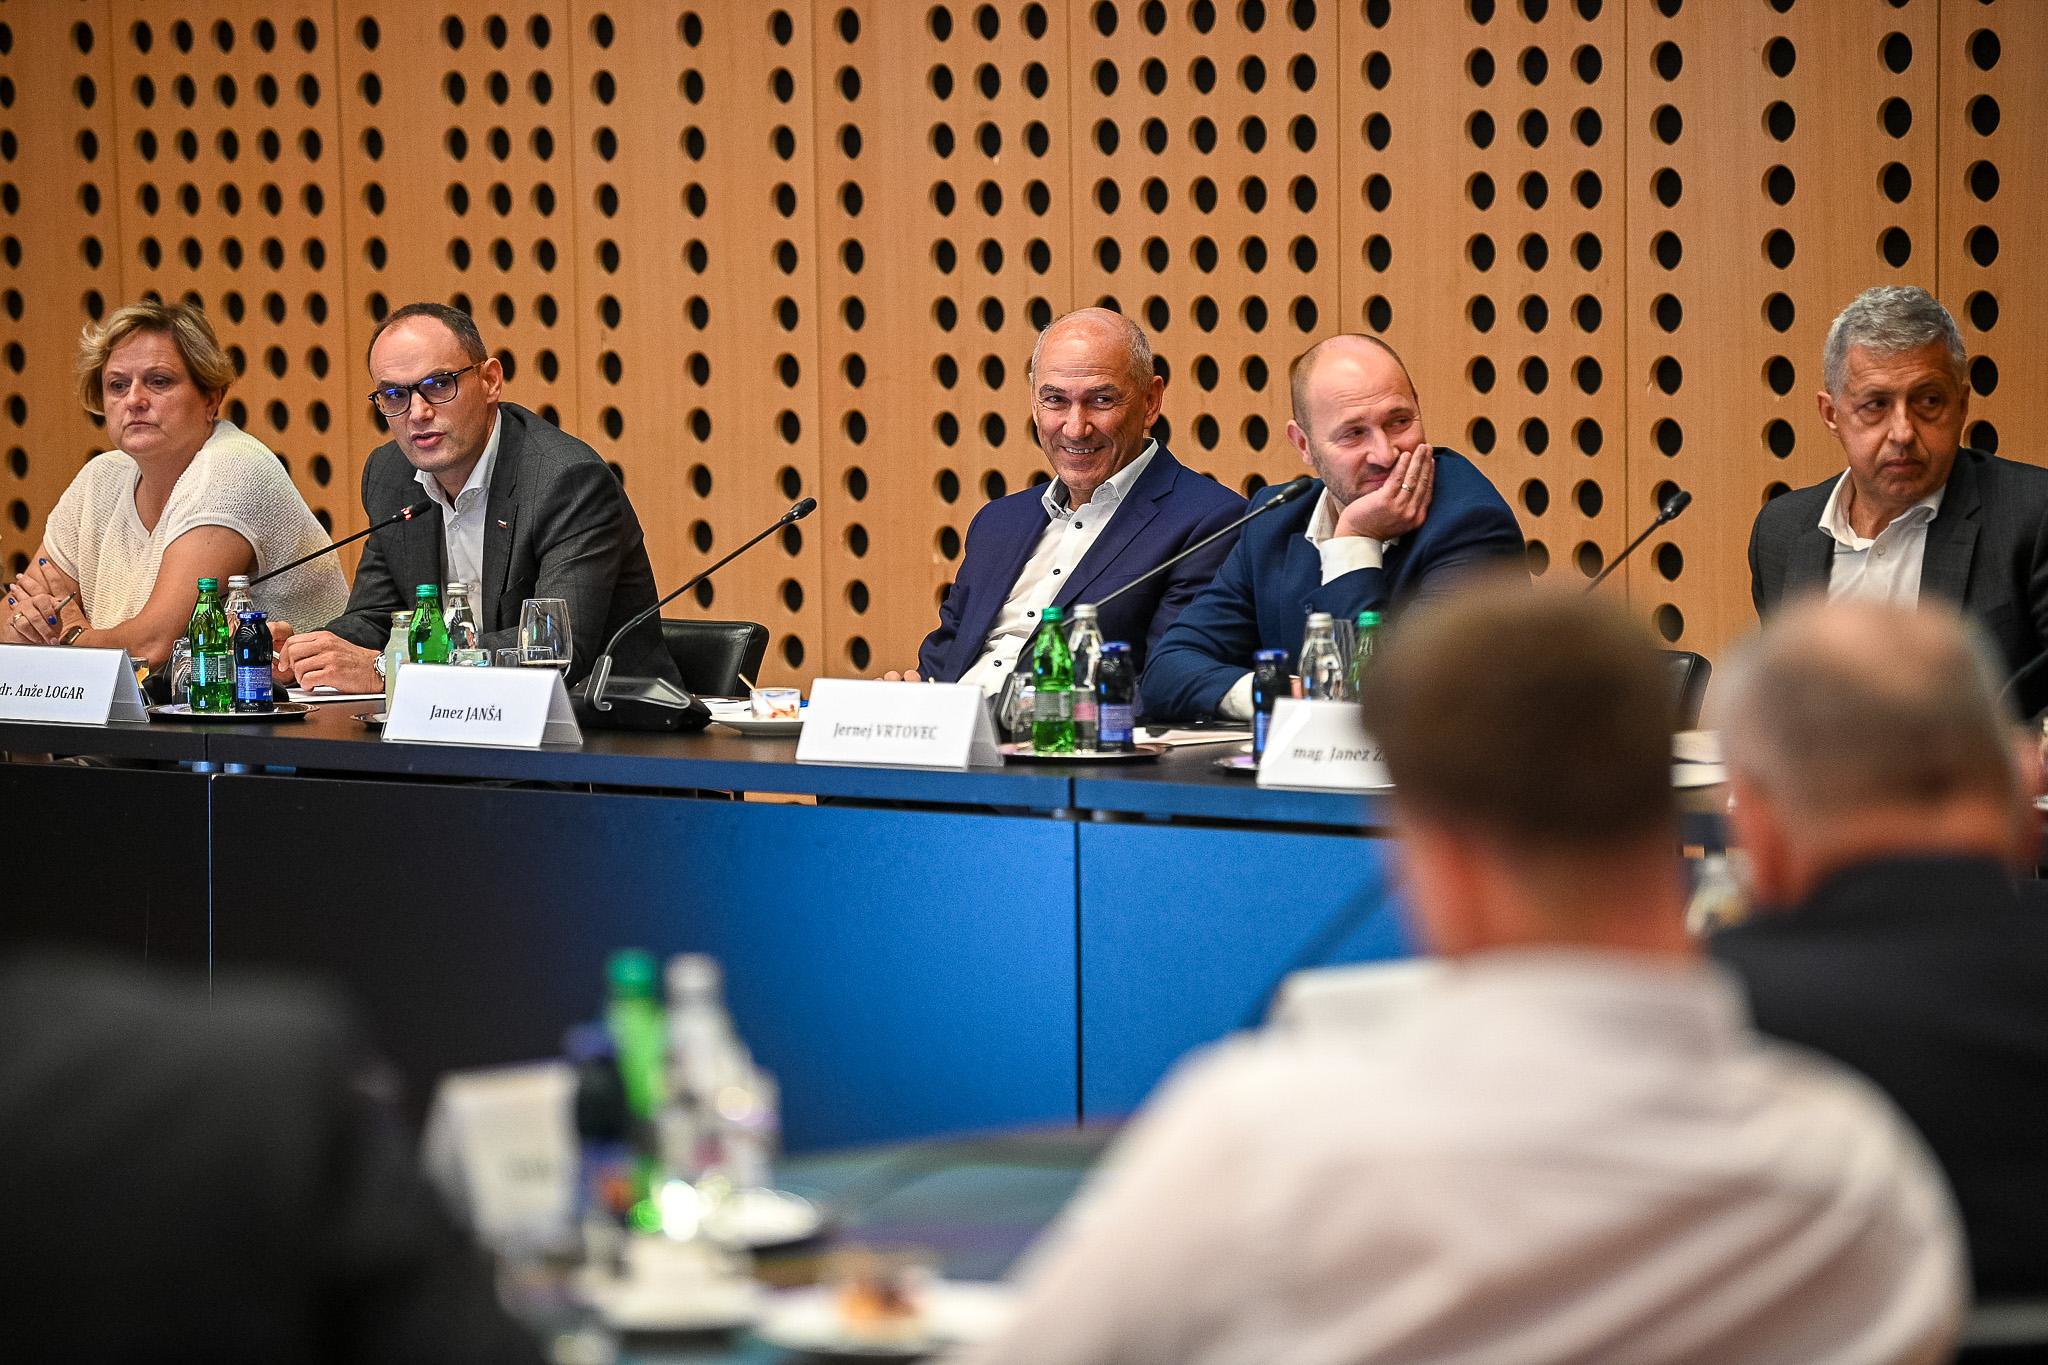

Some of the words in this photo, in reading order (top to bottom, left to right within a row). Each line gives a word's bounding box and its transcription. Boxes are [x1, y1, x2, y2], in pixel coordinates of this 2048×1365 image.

[0, 682, 13, 696] dr.
[15, 683, 44, 697] Anže
[45, 685, 84, 700] LOGAR
[429, 704, 463, 720] Janez
[464, 704, 502, 722] JANŠA
[833, 722, 872, 741] Jernej
[876, 724, 938, 740] VRTOVEC
[1329, 746, 1369, 763] Janez
